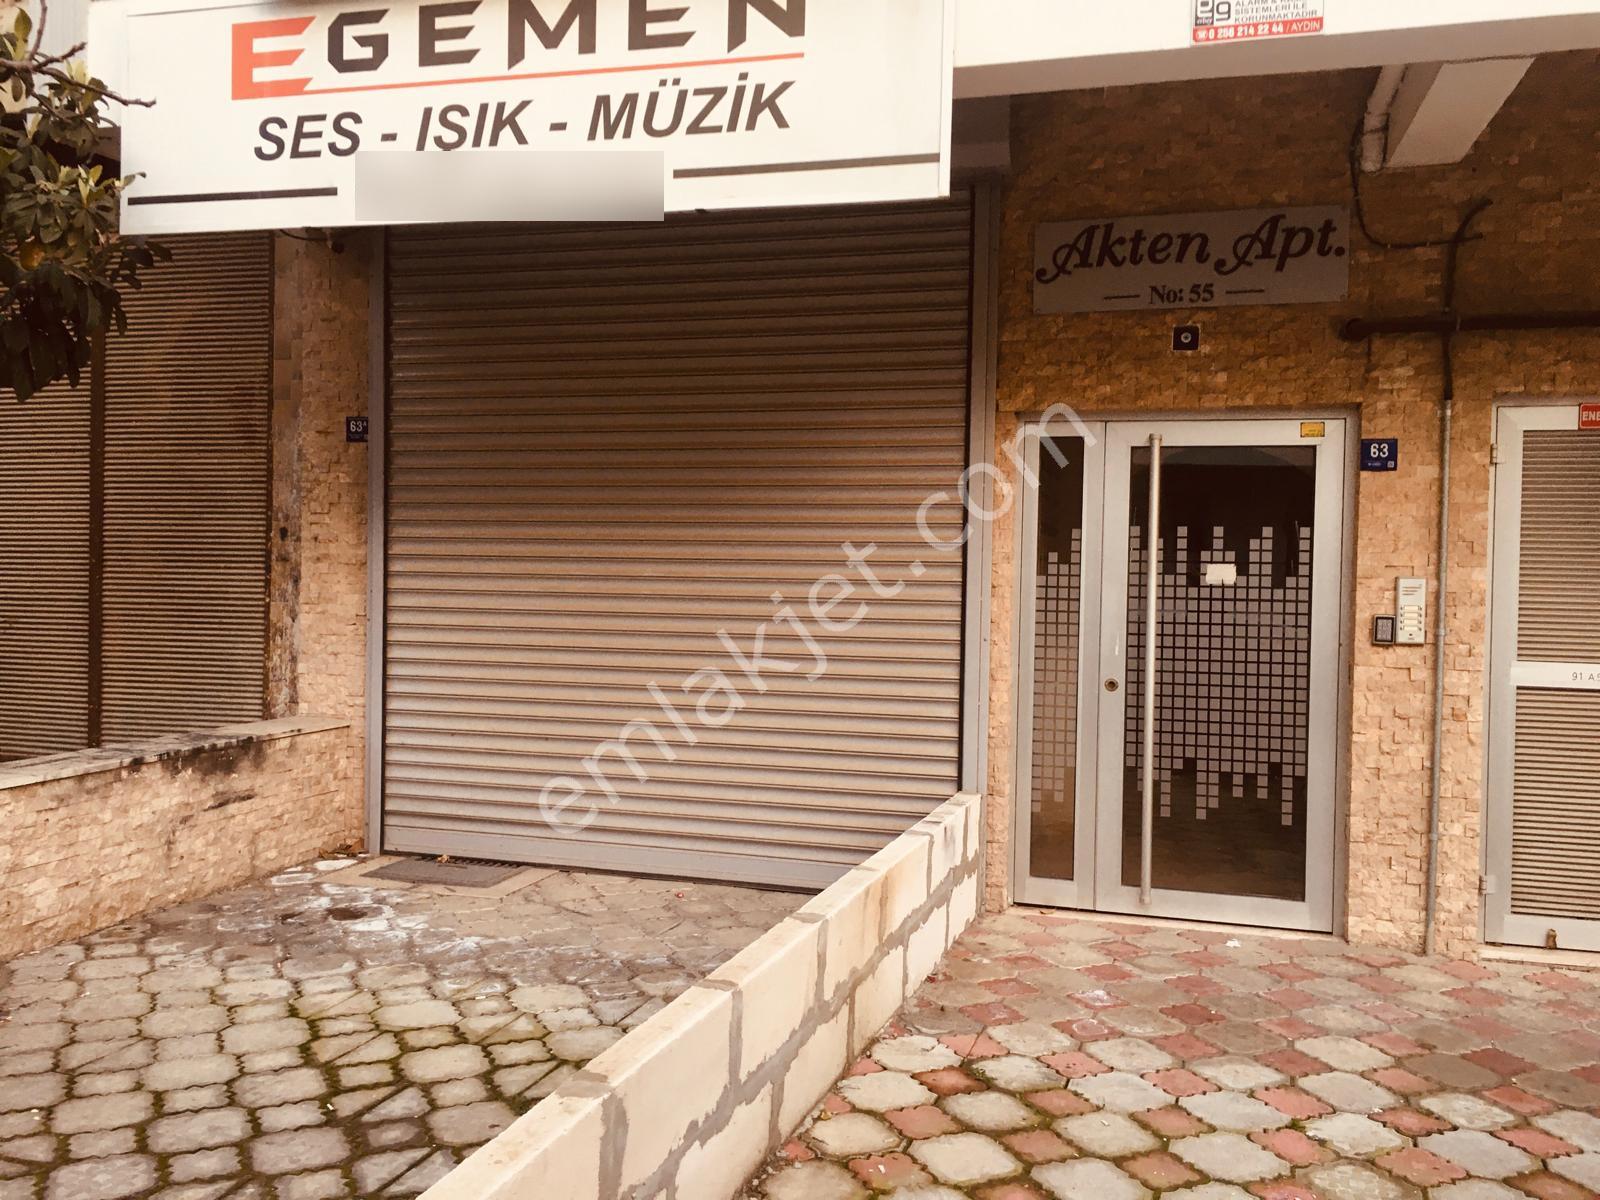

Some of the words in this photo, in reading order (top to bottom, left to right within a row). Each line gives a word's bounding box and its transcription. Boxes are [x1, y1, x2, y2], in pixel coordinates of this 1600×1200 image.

[1291, 19, 1321, 31] AYDIN
[231, 0, 806, 100] EGEMEN
[254, 111, 363, 161] SES
[587, 72, 796, 141] MÜZİK
[1035, 221, 1210, 284] Akten
[1213, 213, 1346, 276] Apt.
[1150, 285, 1184, 304] No:
[1188, 283, 1214, 303] 55
[1370, 443, 1389, 458] 63
[1571, 671, 1583, 681] 91
